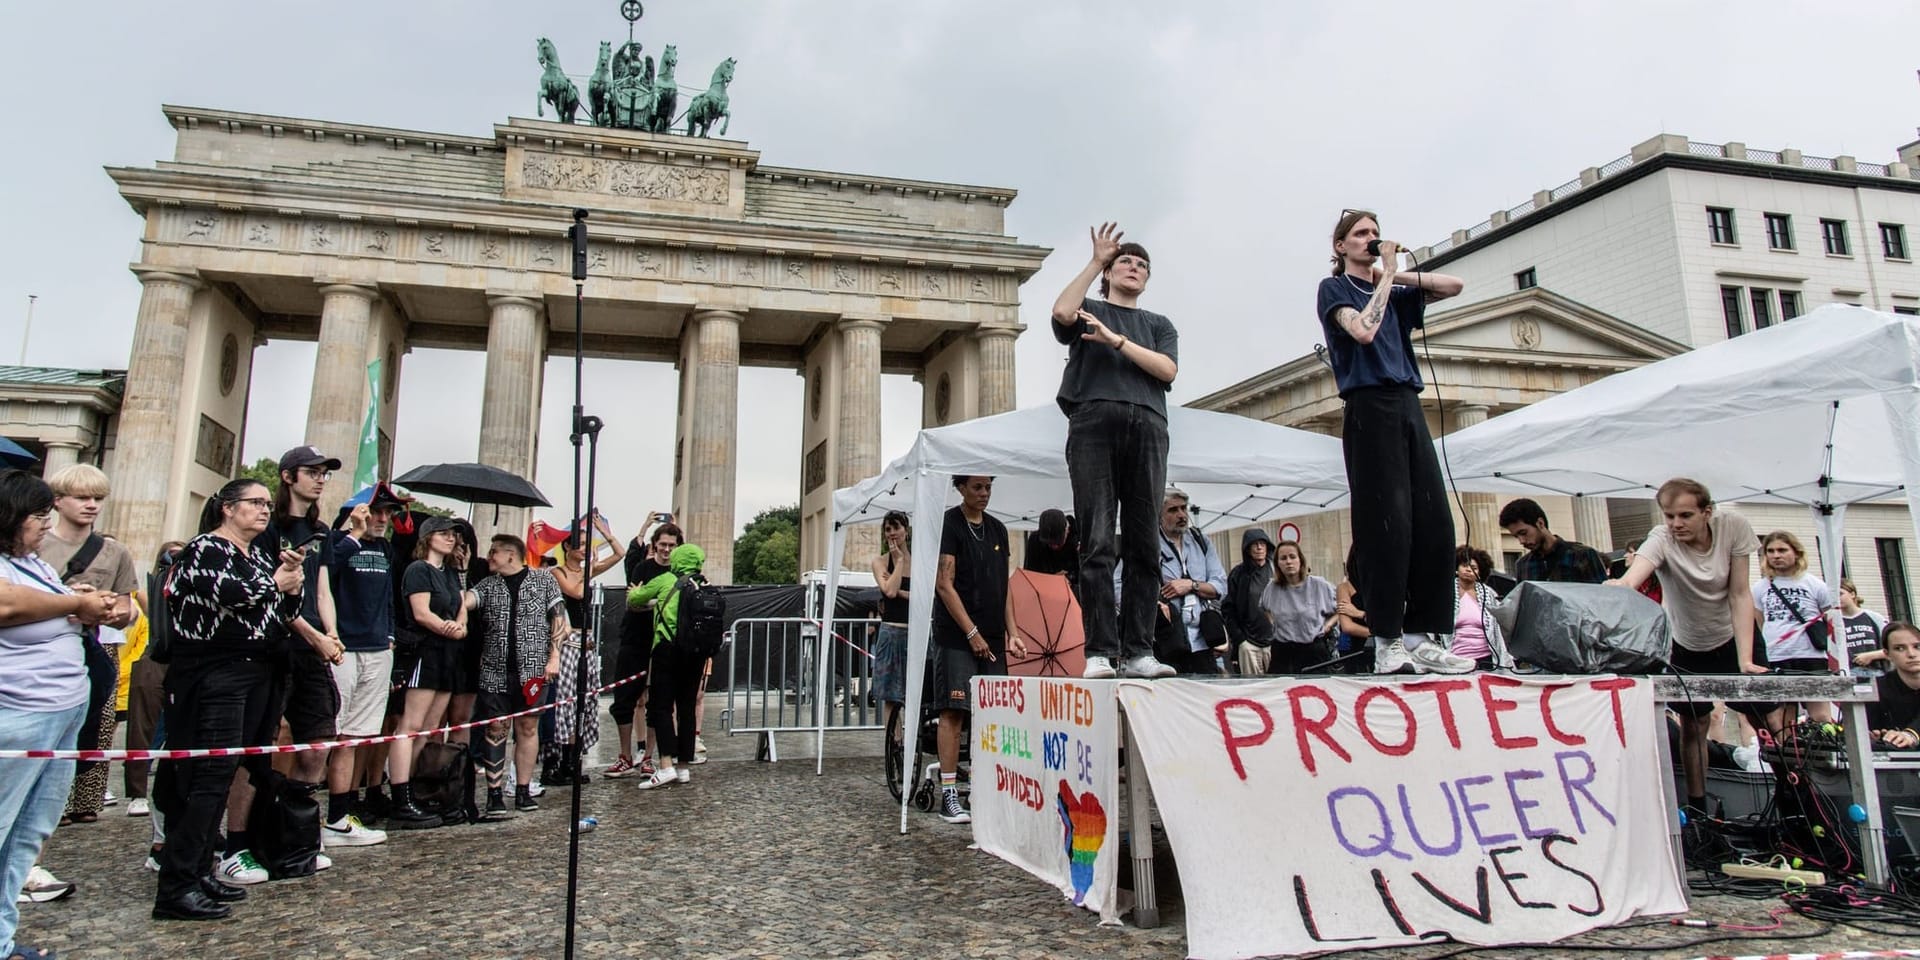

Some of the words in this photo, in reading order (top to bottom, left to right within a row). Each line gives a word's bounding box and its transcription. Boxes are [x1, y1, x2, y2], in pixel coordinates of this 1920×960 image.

[1767, 587, 1809, 597] FGHT
[979, 678, 1024, 714] QUEERS
[1040, 680, 1093, 727] UNITED
[1215, 675, 1636, 781] PROTECT
[981, 723, 997, 752] WE
[1002, 725, 1032, 759] WILL
[1043, 731, 1068, 770] NOT
[1077, 739, 1092, 785] BE
[996, 763, 1044, 811] DIVIDED
[1326, 750, 1616, 861] QUEER
[1293, 834, 1605, 942] LIVES
